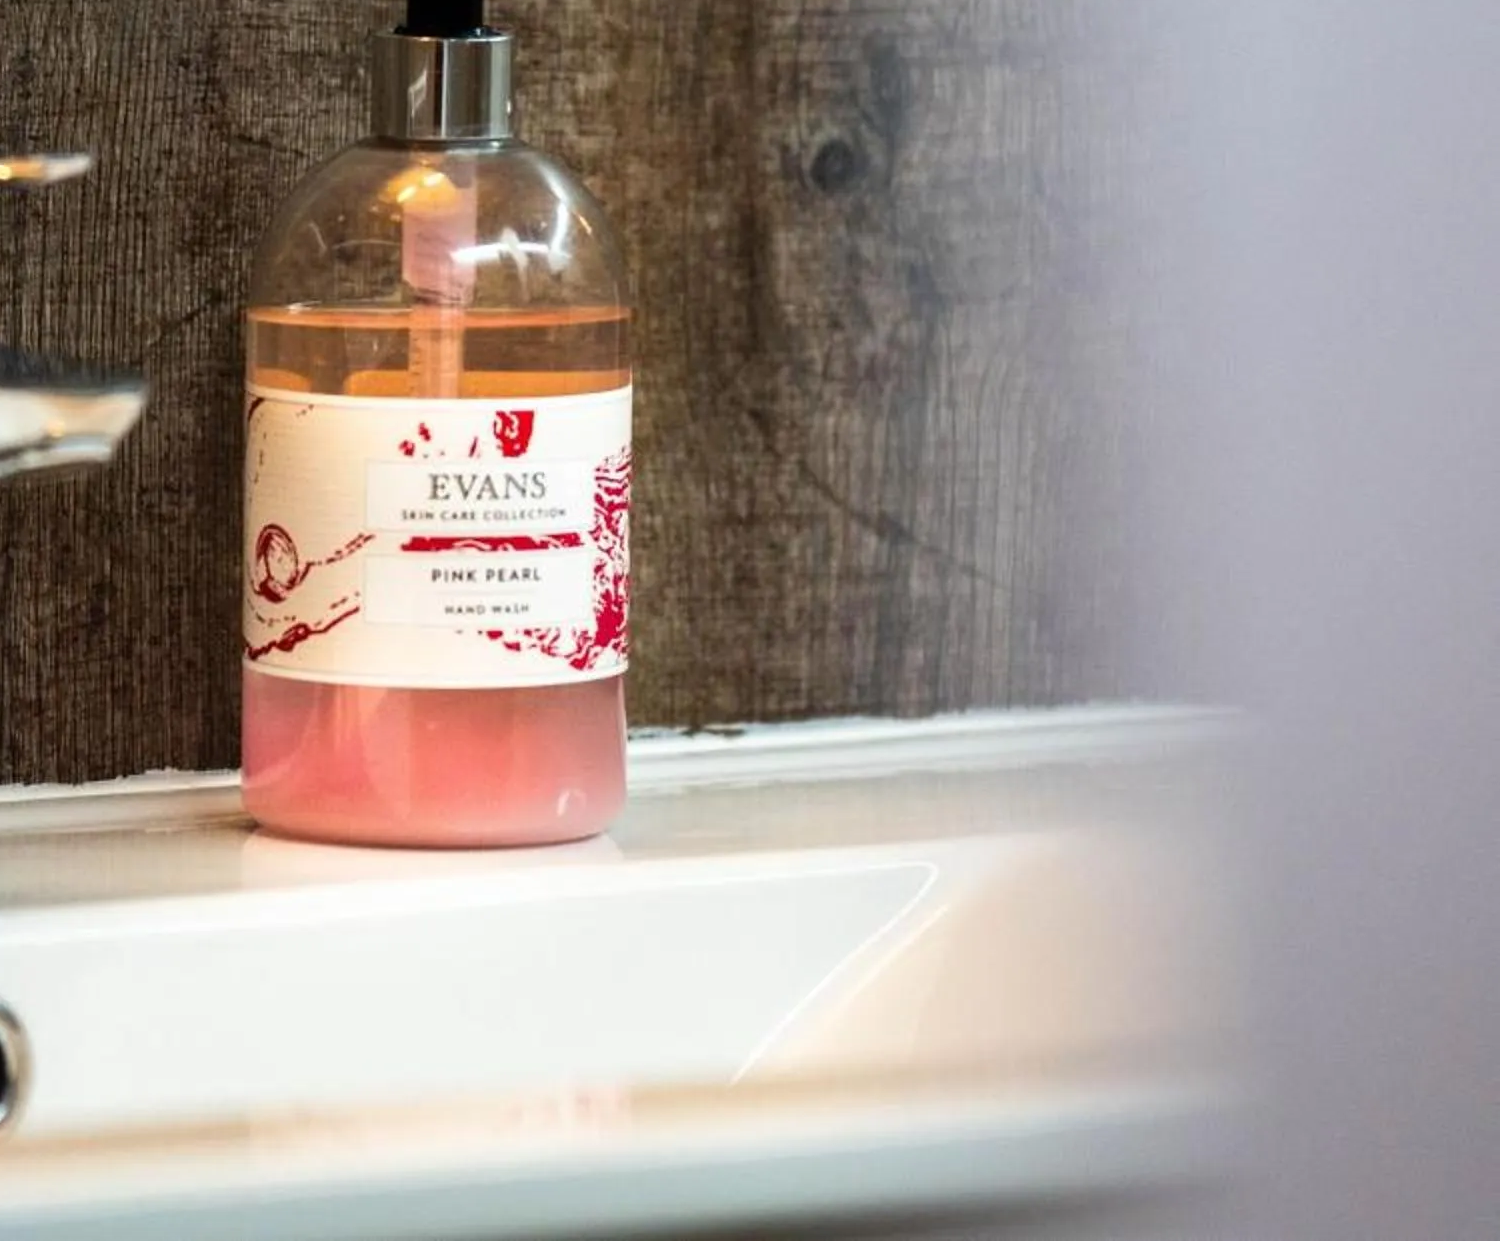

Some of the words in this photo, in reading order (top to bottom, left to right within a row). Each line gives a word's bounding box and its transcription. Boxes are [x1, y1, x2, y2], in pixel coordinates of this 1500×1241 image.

[428, 472, 547, 501] EVANS
[402, 509, 434, 521] SKIN
[440, 510, 476, 521] CARE
[483, 508, 567, 521] COLLECTION
[431, 568, 477, 583] PINK
[485, 567, 542, 582] PEARL
[444, 604, 486, 616] HAND
[491, 603, 530, 615] WASH
